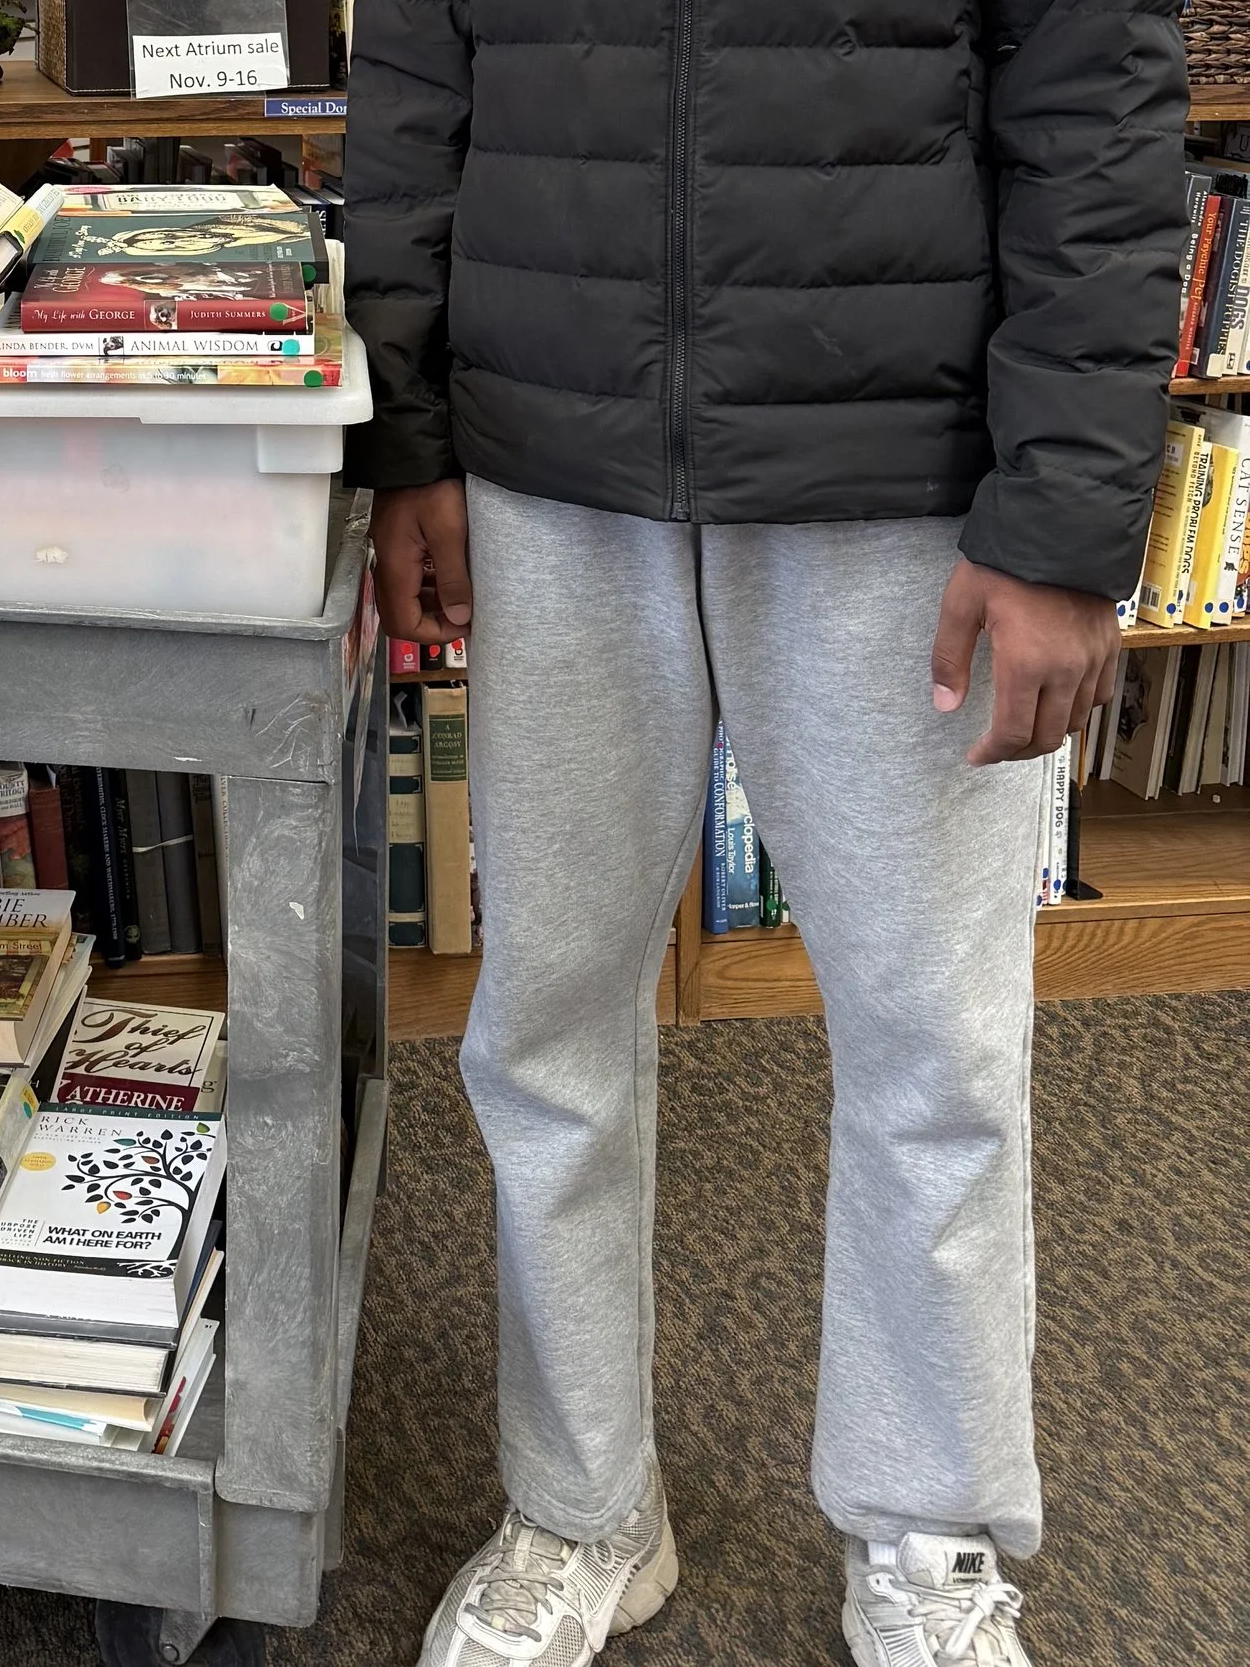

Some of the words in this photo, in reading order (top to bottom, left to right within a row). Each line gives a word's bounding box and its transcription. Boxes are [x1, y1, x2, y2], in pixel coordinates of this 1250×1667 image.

[142, 44, 181, 59] Next
[186, 40, 242, 57] Atrium
[248, 39, 279, 55] sale
[170, 72, 211, 90] Nov.
[216, 70, 258, 87] 9-16
[281, 101, 324, 116] Special
[1205, 211, 1217, 235] Your
[1235, 220, 1249, 248] THE
[1185, 233, 1199, 261] Being
[1197, 238, 1212, 275] Psychic
[1226, 254, 1243, 299] DOGIST
[1190, 277, 1206, 302] Pet
[32, 309, 48, 322] My
[51, 309, 67, 322] Life
[70, 310, 87, 321] with
[89, 309, 135, 321] GEORGE
[190, 310, 222, 319] JUDITH
[225, 311, 266, 319] SUMMERS
[72, 342, 94, 351] DVM
[131, 340, 190, 352] ANIMAL
[193, 340, 259, 352] WISDOM
[3, 367, 38, 378] bloom
[41, 370, 59, 380] fresh
[61, 370, 85, 380] flower
[86, 371, 135, 382] arrangements
[177, 371, 206, 380] minutes
[1190, 451, 1200, 479] BEYOND
[1193, 452, 1209, 498] TRAINING
[1227, 497, 1247, 556] SENSE
[1055, 766, 1067, 801] HAPPY
[713, 782, 726, 857] CONFORMATION
[1054, 806, 1064, 829] DOG
[727, 827, 736, 850] Louis
[727, 850, 736, 875] Taylor
[12, 942, 43, 950] Street
[72, 1009, 206, 1045] Thief
[125, 1038, 166, 1058] of
[64, 1048, 203, 1076] Hearts
[41, 1116, 88, 1125] RICK
[102, 1109, 138, 1117] PRINT
[148, 1112, 199, 1120] EDITION
[39, 1124, 122, 1136] WARREN
[43, 1235, 69, 1245] AM
[75, 1238, 114, 1247] HERE
[115, 1240, 151, 1250] FOR?
[48, 1226, 90, 1238] WHAT
[93, 1229, 114, 1238] ON
[115, 1230, 162, 1241] EARTH
[952, 1551, 985, 1574] NIKE
